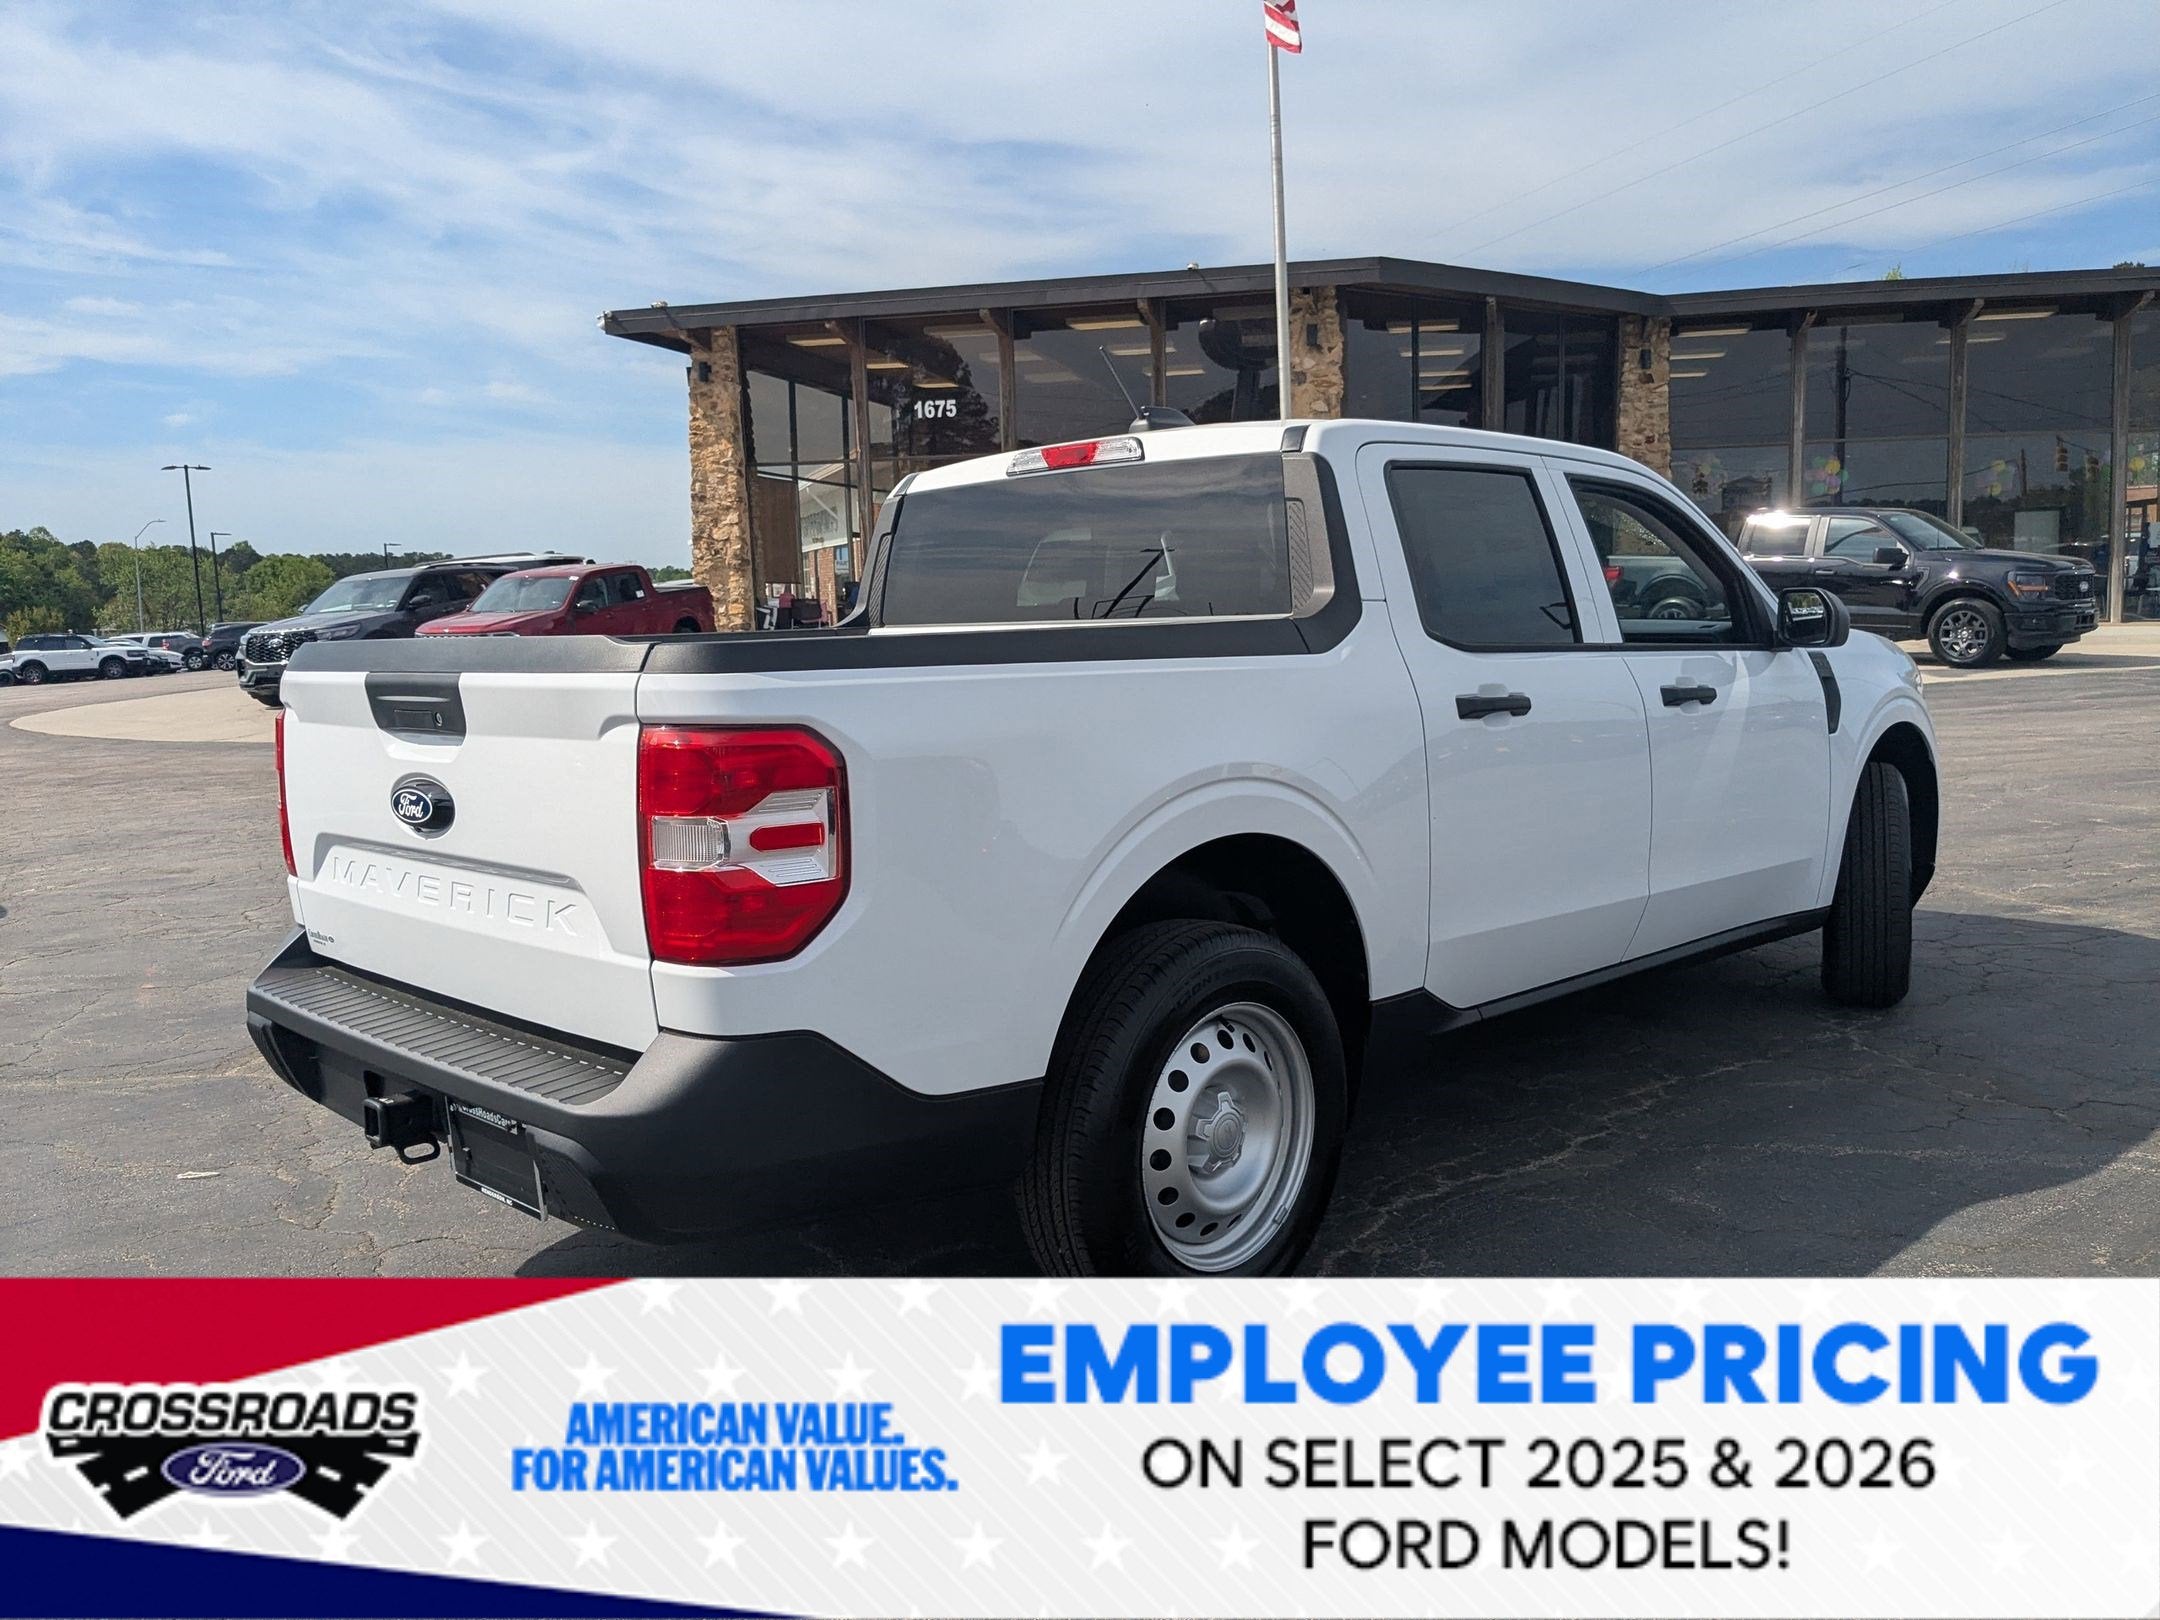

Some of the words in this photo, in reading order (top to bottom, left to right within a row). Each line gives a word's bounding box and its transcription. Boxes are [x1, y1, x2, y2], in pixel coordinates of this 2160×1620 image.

[914, 399, 957, 419] 1675
[398, 793, 424, 818] Ford
[332, 856, 579, 937] MAVERICK
